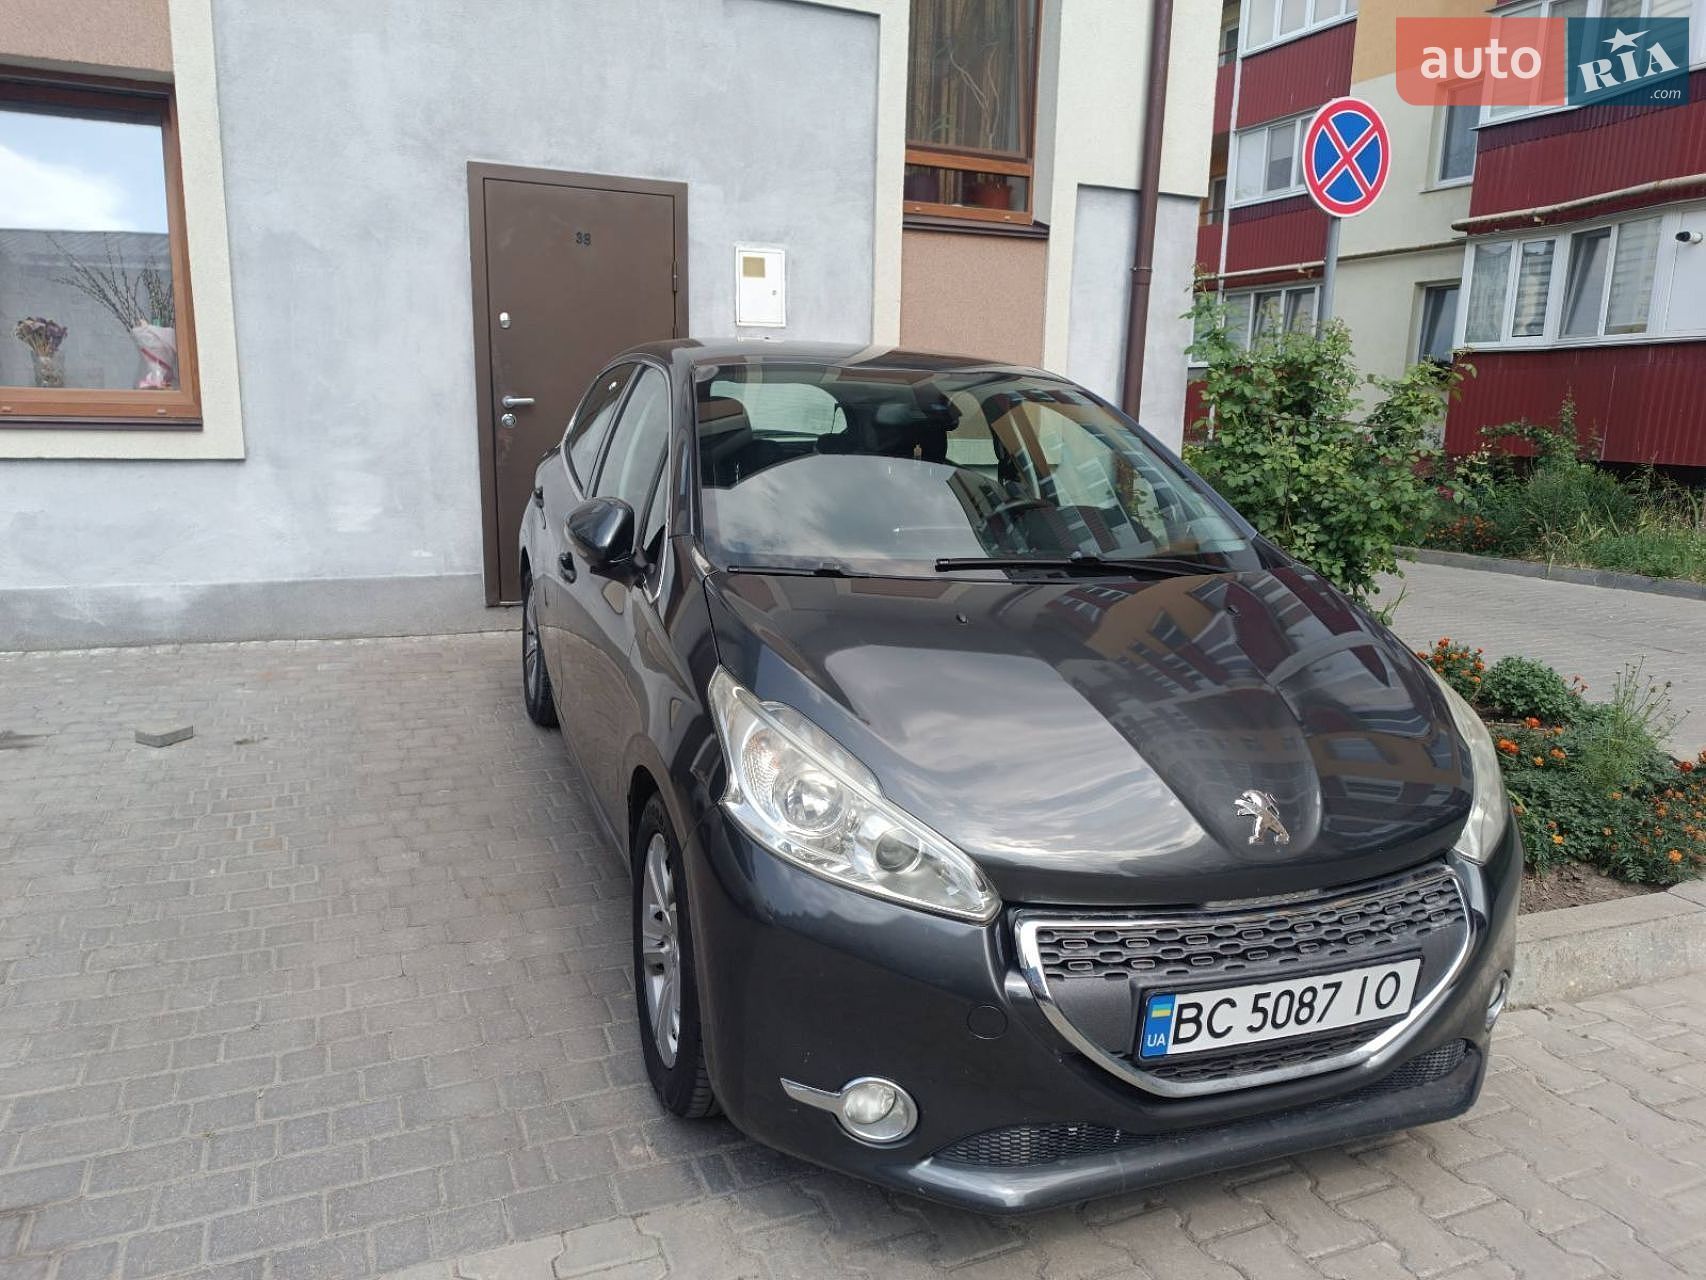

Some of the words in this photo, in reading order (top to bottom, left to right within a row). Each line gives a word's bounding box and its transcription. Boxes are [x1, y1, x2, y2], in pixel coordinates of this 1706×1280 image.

[1172, 997, 1238, 1046] BC
[1246, 980, 1343, 1034] 5087
[1355, 970, 1401, 1016] IO
[1147, 1033, 1167, 1048] UA
